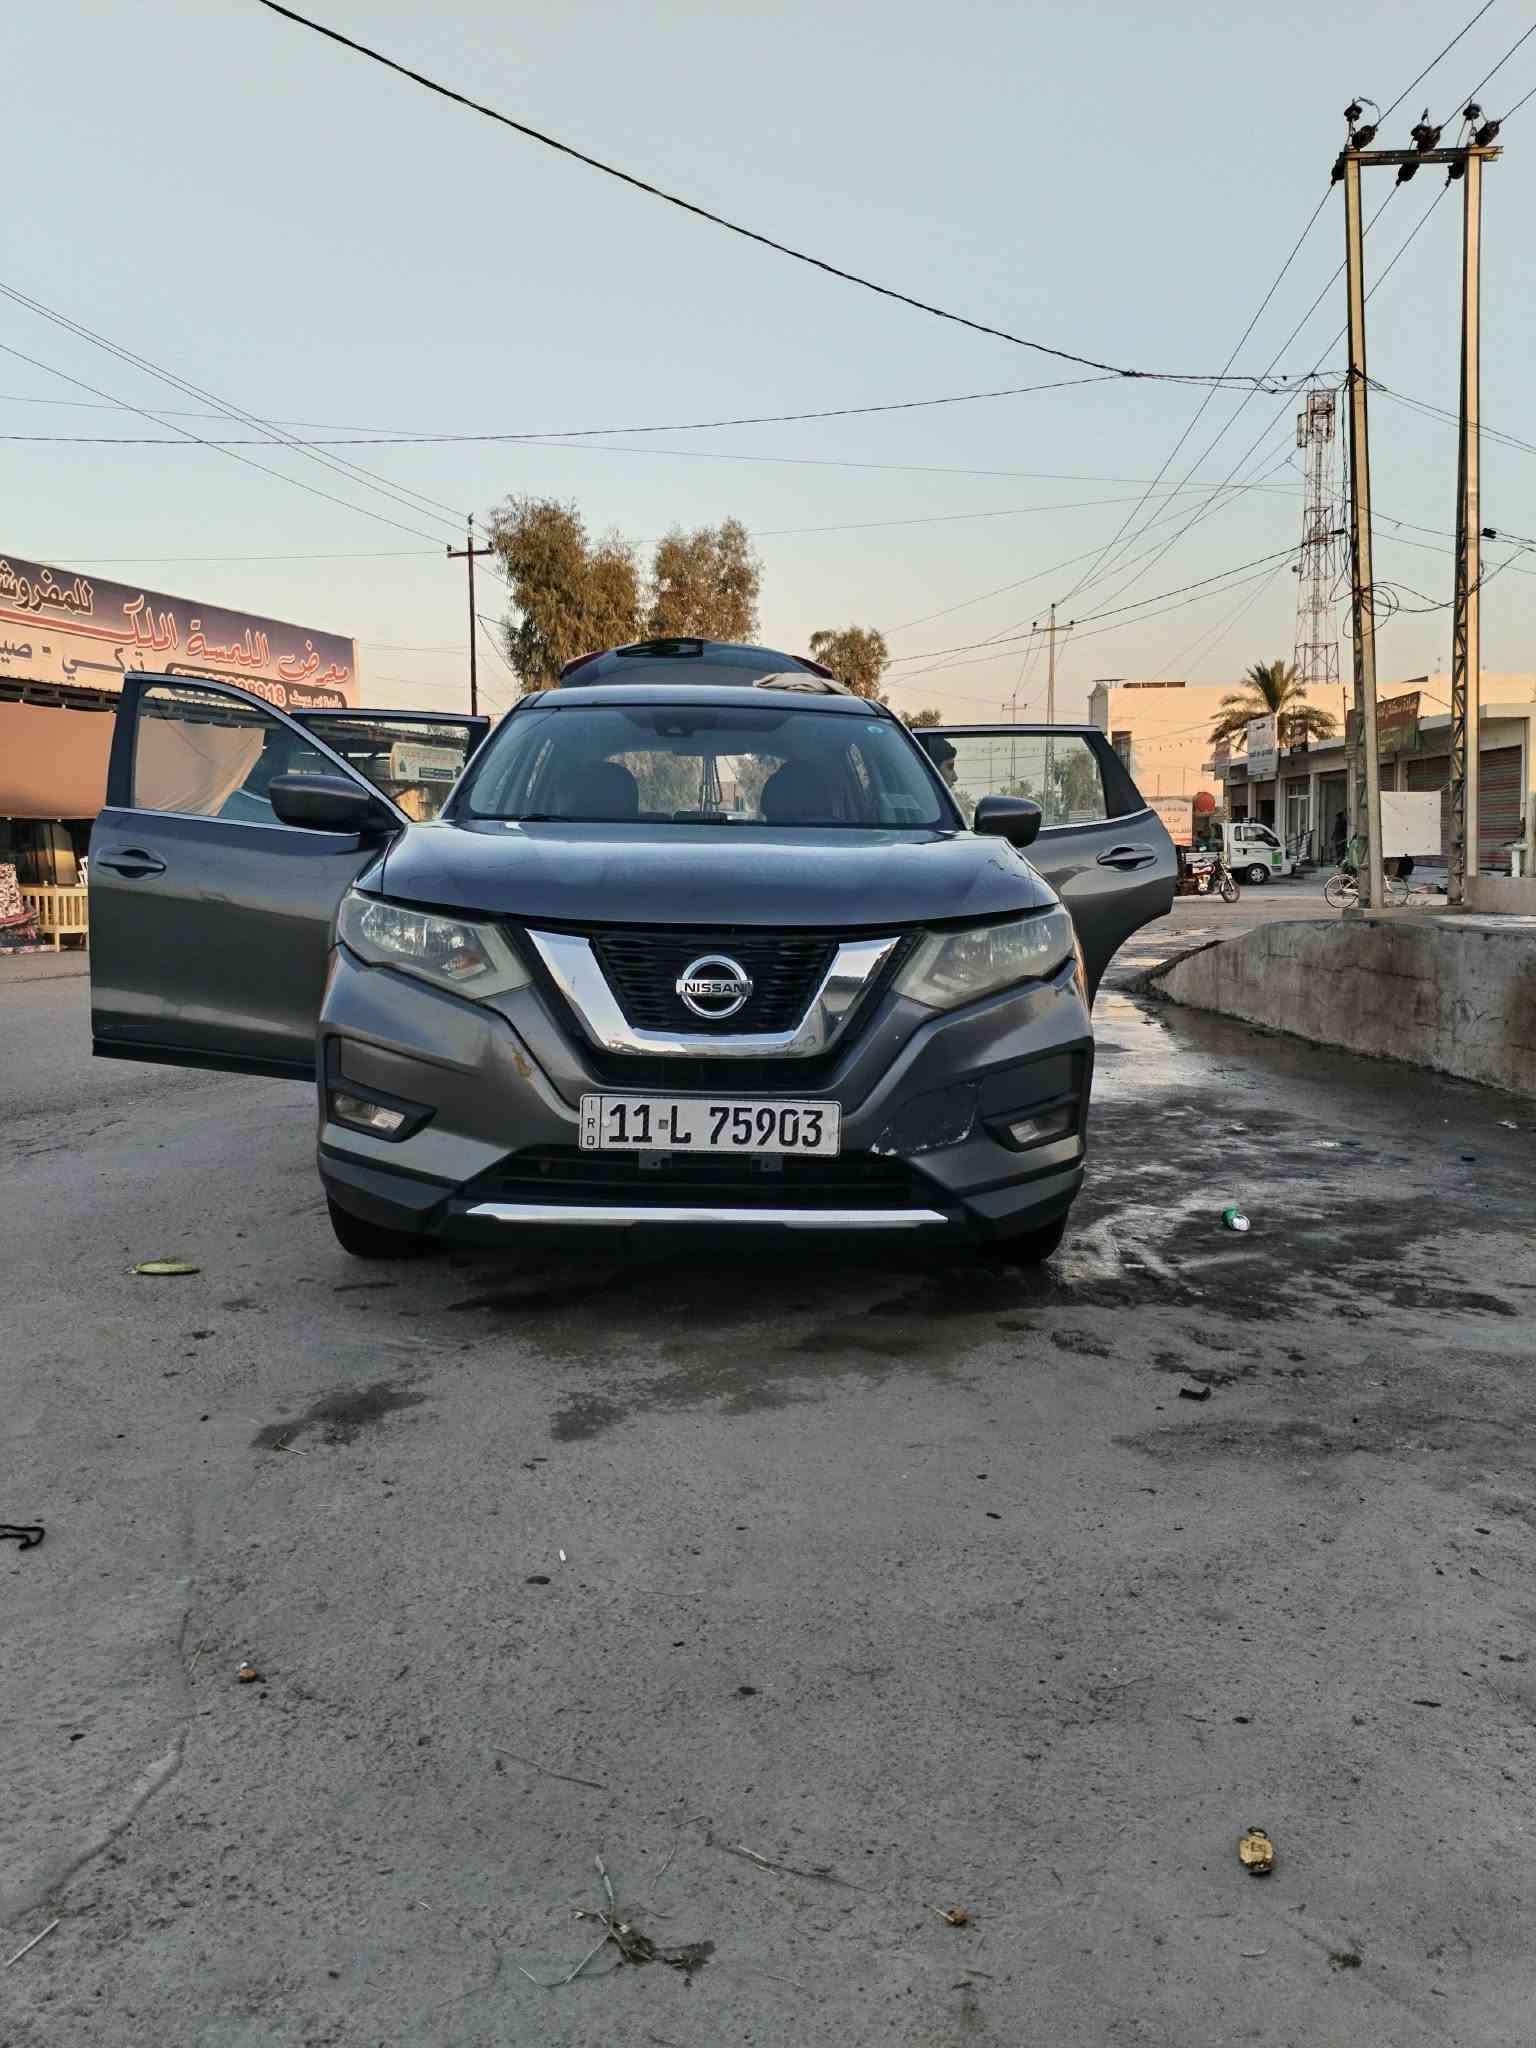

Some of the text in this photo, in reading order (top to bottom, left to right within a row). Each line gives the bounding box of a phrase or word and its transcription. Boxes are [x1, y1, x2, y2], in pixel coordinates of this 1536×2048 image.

[0, 560, 93, 616] للمفروش
[684, 982, 744, 993] NISSAN
[608, 1104, 652, 1143] 11
[708, 1106, 823, 1147] 75903
